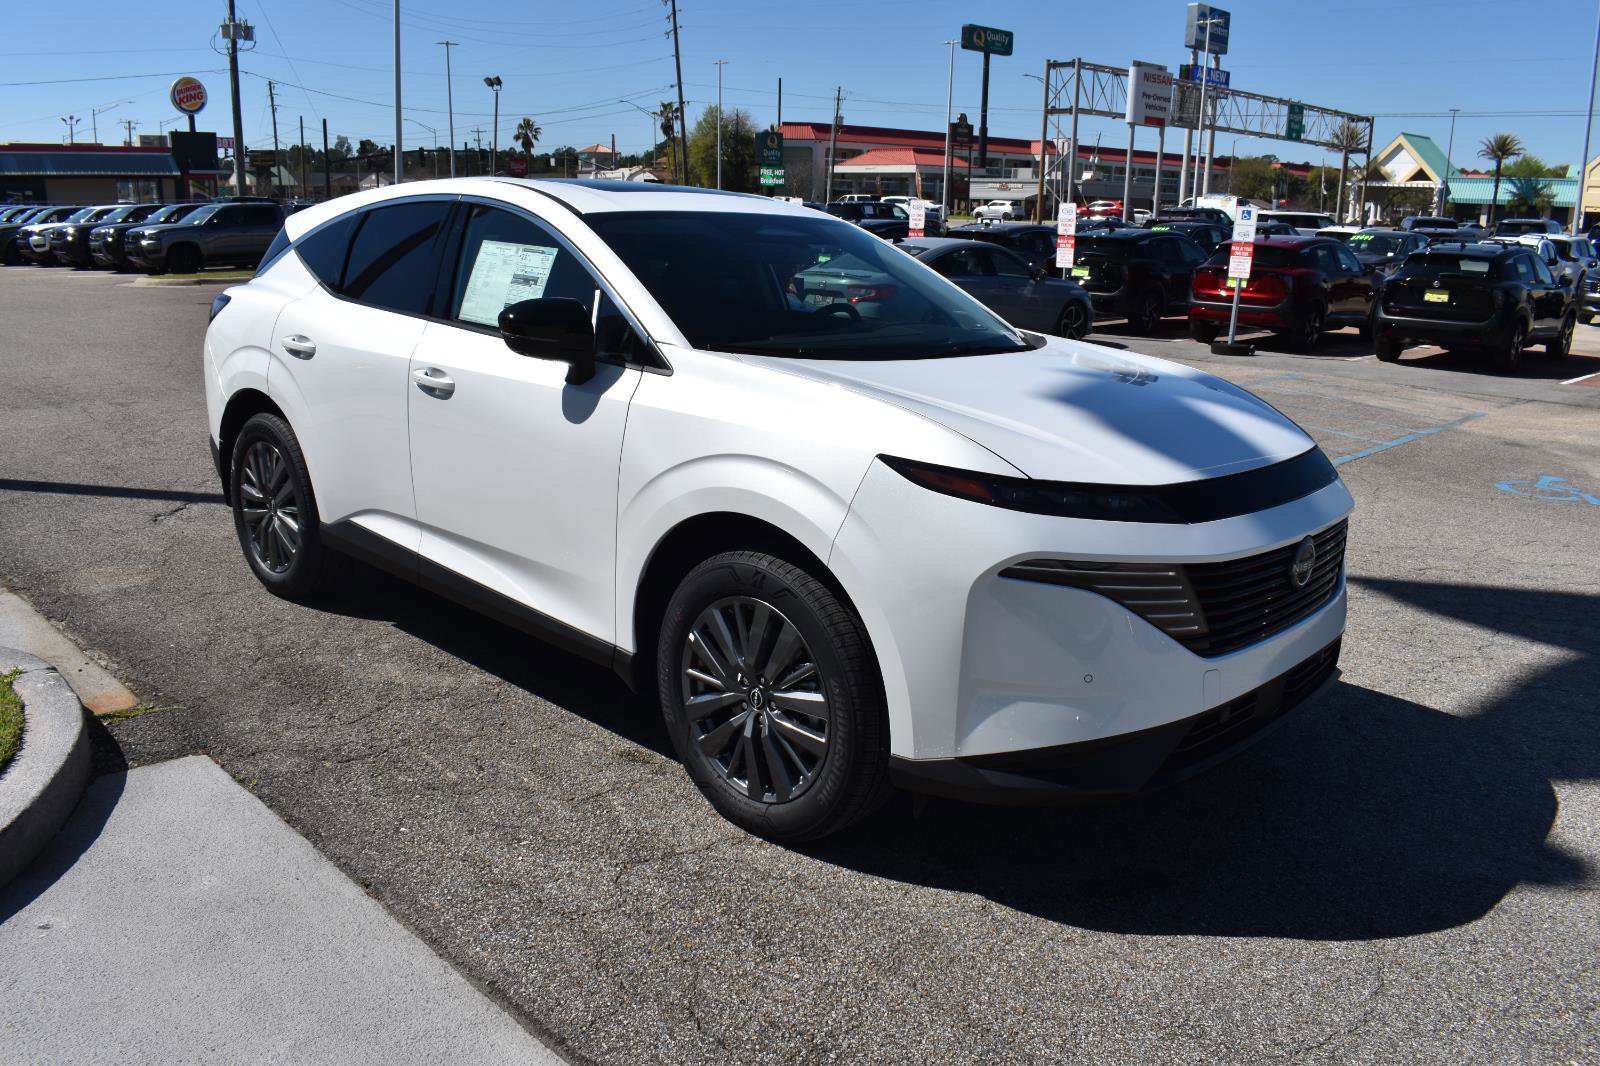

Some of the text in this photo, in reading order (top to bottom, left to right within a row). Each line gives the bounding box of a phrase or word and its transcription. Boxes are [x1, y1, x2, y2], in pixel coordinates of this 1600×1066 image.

[987, 31, 1010, 45] Quality
[1143, 71, 1173, 86] NISSAN
[1210, 69, 1227, 83] NEW
[176, 83, 202, 96] BURGER
[178, 91, 204, 105] KING
[1142, 91, 1171, 103] Pre-Owned
[1144, 102, 1167, 112] Vehicles
